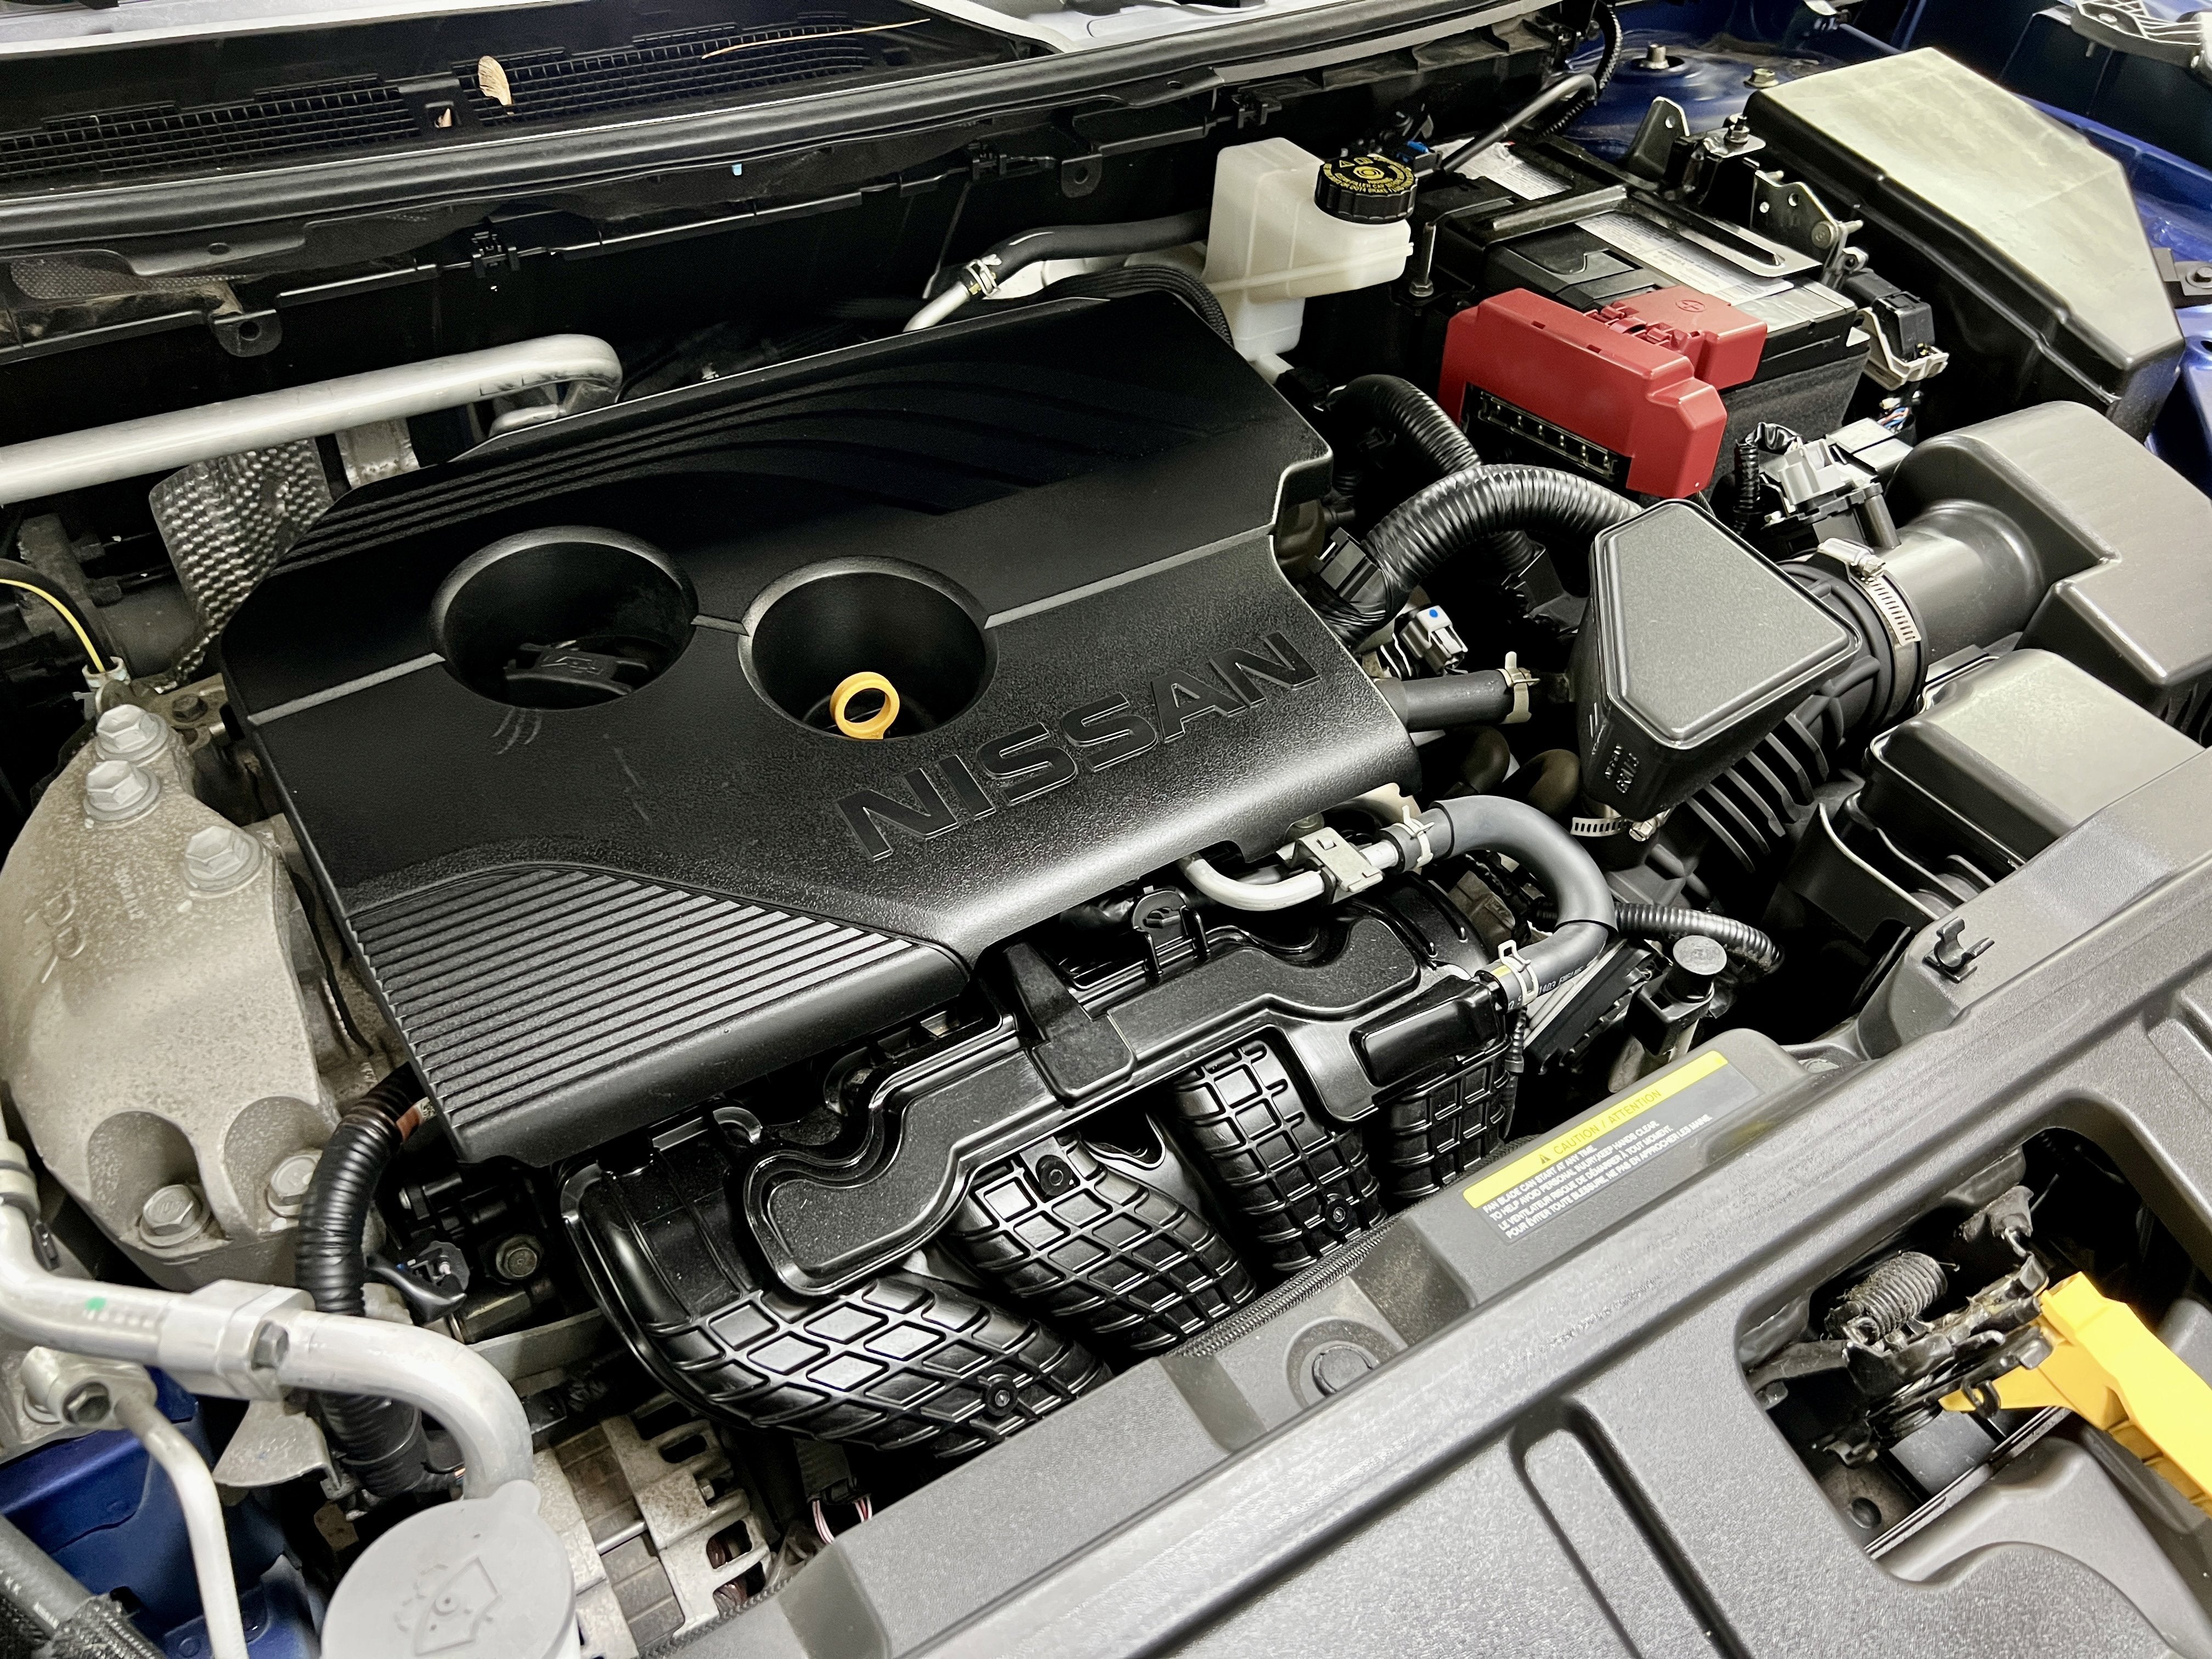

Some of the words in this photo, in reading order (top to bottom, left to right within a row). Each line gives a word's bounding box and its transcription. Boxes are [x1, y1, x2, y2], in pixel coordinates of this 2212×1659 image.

[836, 631, 1321, 861] NISSAN
[1489, 1211, 1503, 1221] TO
[1500, 1200, 1519, 1215] HELP
[1519, 1188, 1542, 1205] AVOID
[1539, 1169, 1577, 1193] PERSONAL
[1612, 1132, 1638, 1150] HANDS
[1635, 1120, 1660, 1137] CLEAR.
[1553, 1125, 1600, 1154] CAUTION
[1601, 1120, 1607, 1128] /
[1607, 1090, 1661, 1124] ATTENTION
[1482, 1200, 1499, 1214] FAN
[1497, 1188, 1522, 1205] BLADE
[1519, 1179, 1536, 1192] CAN
[1534, 1167, 1557, 1183] START
[1565, 1154, 1579, 1167] ANY
[1498, 1220, 1510, 1231] LE
[1507, 1195, 1553, 1224] VENTILATEUR
[1549, 1181, 1578, 1200] RISQUE
[1575, 1175, 1588, 1186] DE
[1624, 1141, 1645, 1155] TOUT
[1642, 1125, 1674, 1145] MOMENT.
[1505, 1222, 1529, 1239] POUR
[1525, 1209, 1552, 1227] ÉVITER
[1549, 1195, 1573, 1213] TOUTE
[1605, 1169, 1618, 1180] NE
[1615, 1161, 1632, 1173] PAS
[1628, 1155, 1641, 1166] EN
[1639, 1132, 1680, 1160] APPROCHER
[1676, 1125, 1691, 1137] LES
[1688, 1114, 1713, 1130] MAINS.
